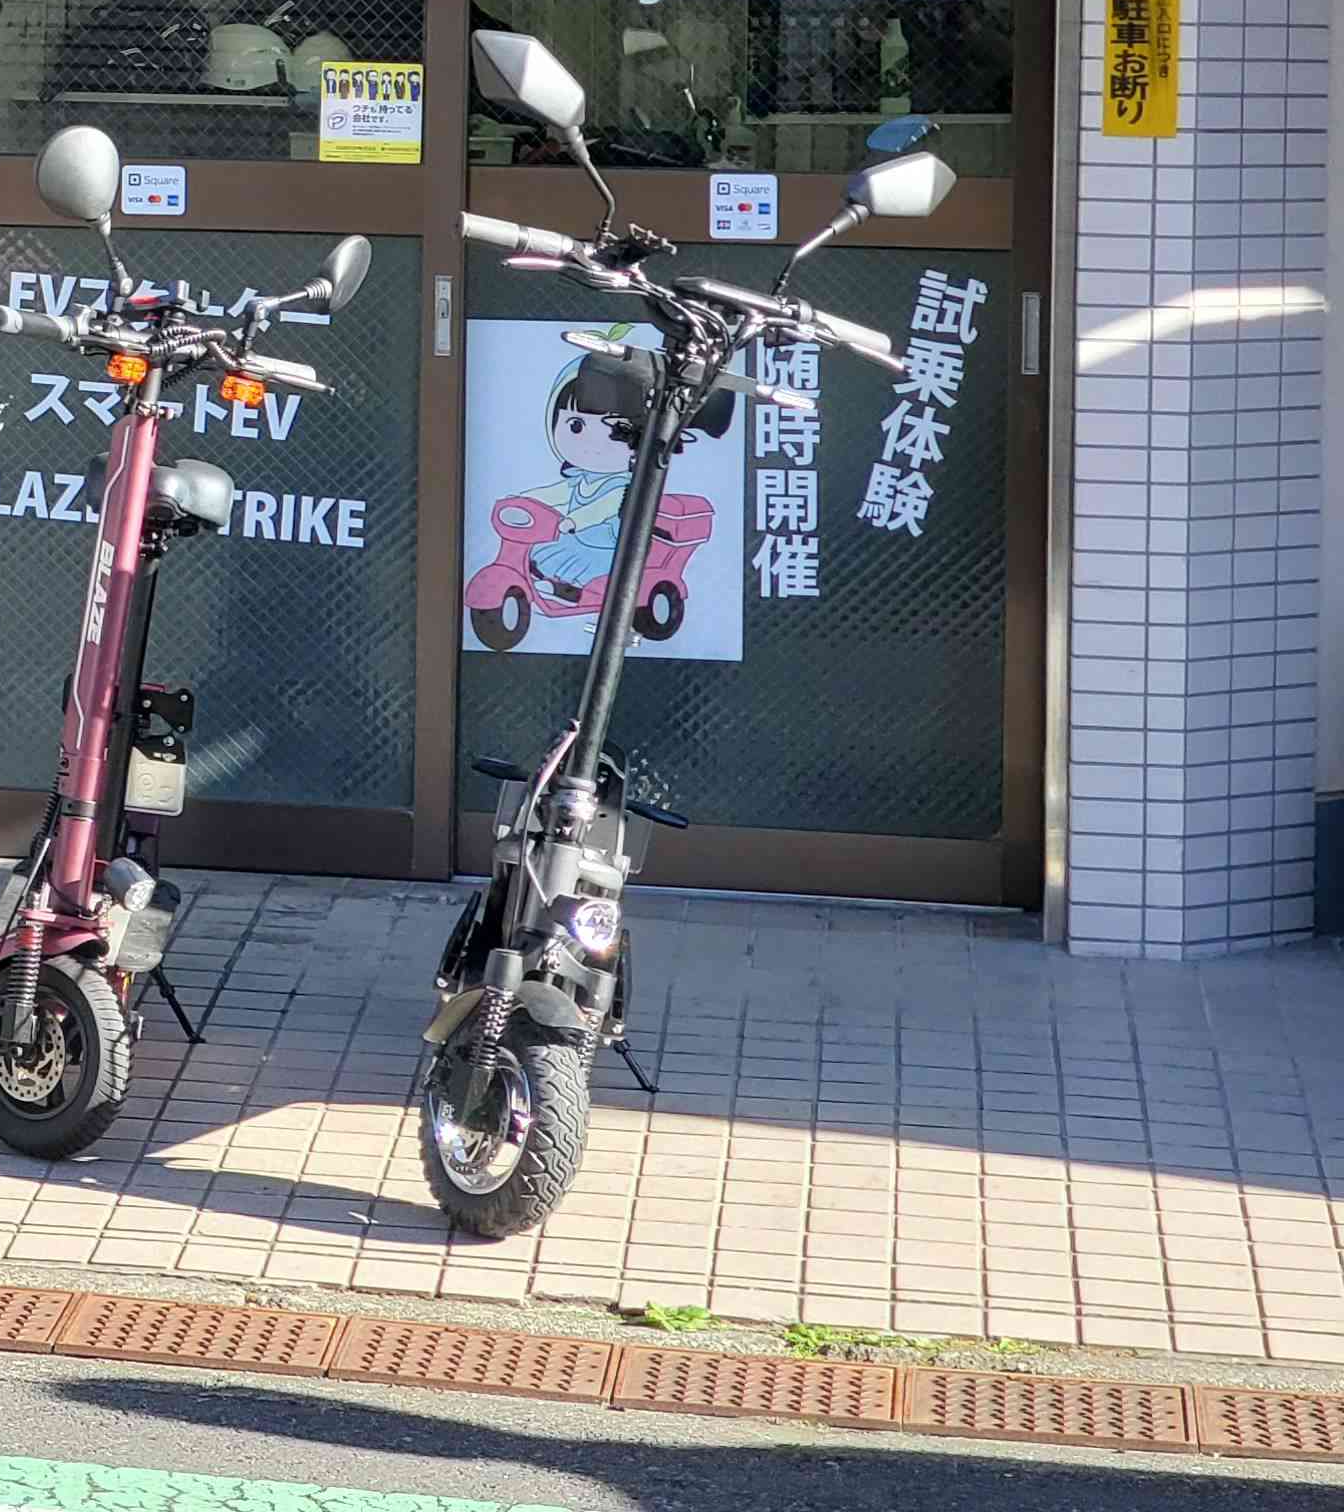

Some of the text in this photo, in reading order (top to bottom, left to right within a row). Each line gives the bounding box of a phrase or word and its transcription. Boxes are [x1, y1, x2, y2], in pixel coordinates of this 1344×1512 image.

[752, 337, 822, 599] 随時開催
[857, 269, 992, 538] 試乗体験
[86, 539, 116, 647] BLAZE
